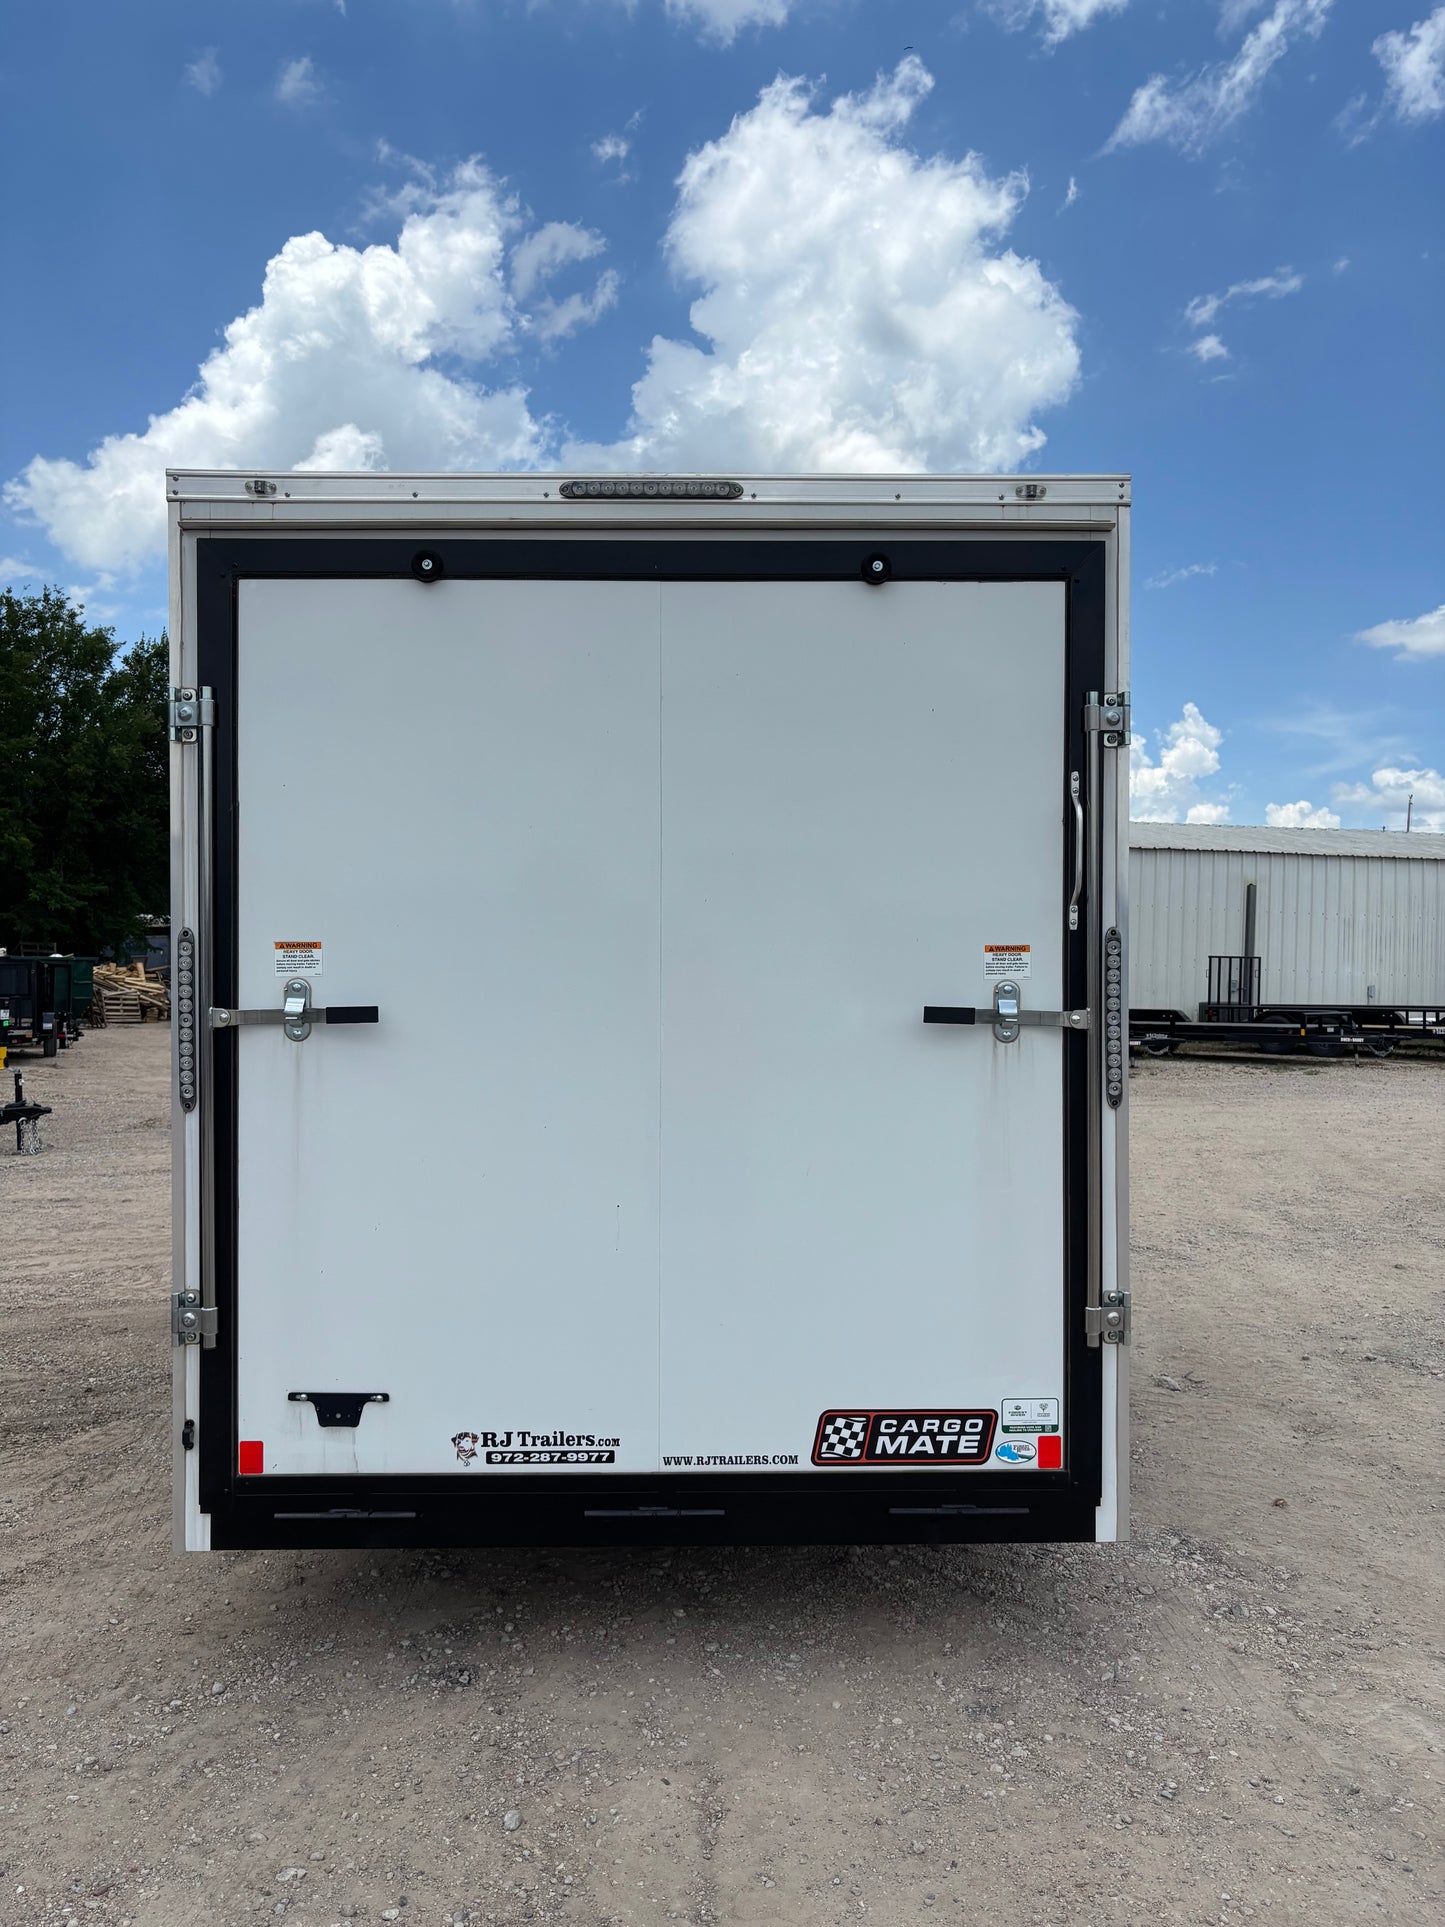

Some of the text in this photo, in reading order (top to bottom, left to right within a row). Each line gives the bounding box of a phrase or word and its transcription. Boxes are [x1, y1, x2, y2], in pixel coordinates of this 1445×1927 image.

[880, 1419, 984, 1433] CARGO
[481, 1431, 513, 1447] RJ
[875, 1435, 980, 1454] MATE
[491, 1452, 610, 1462] 972-287-9977
[662, 1454, 799, 1466] WWW.RJTRAILERS.COM
